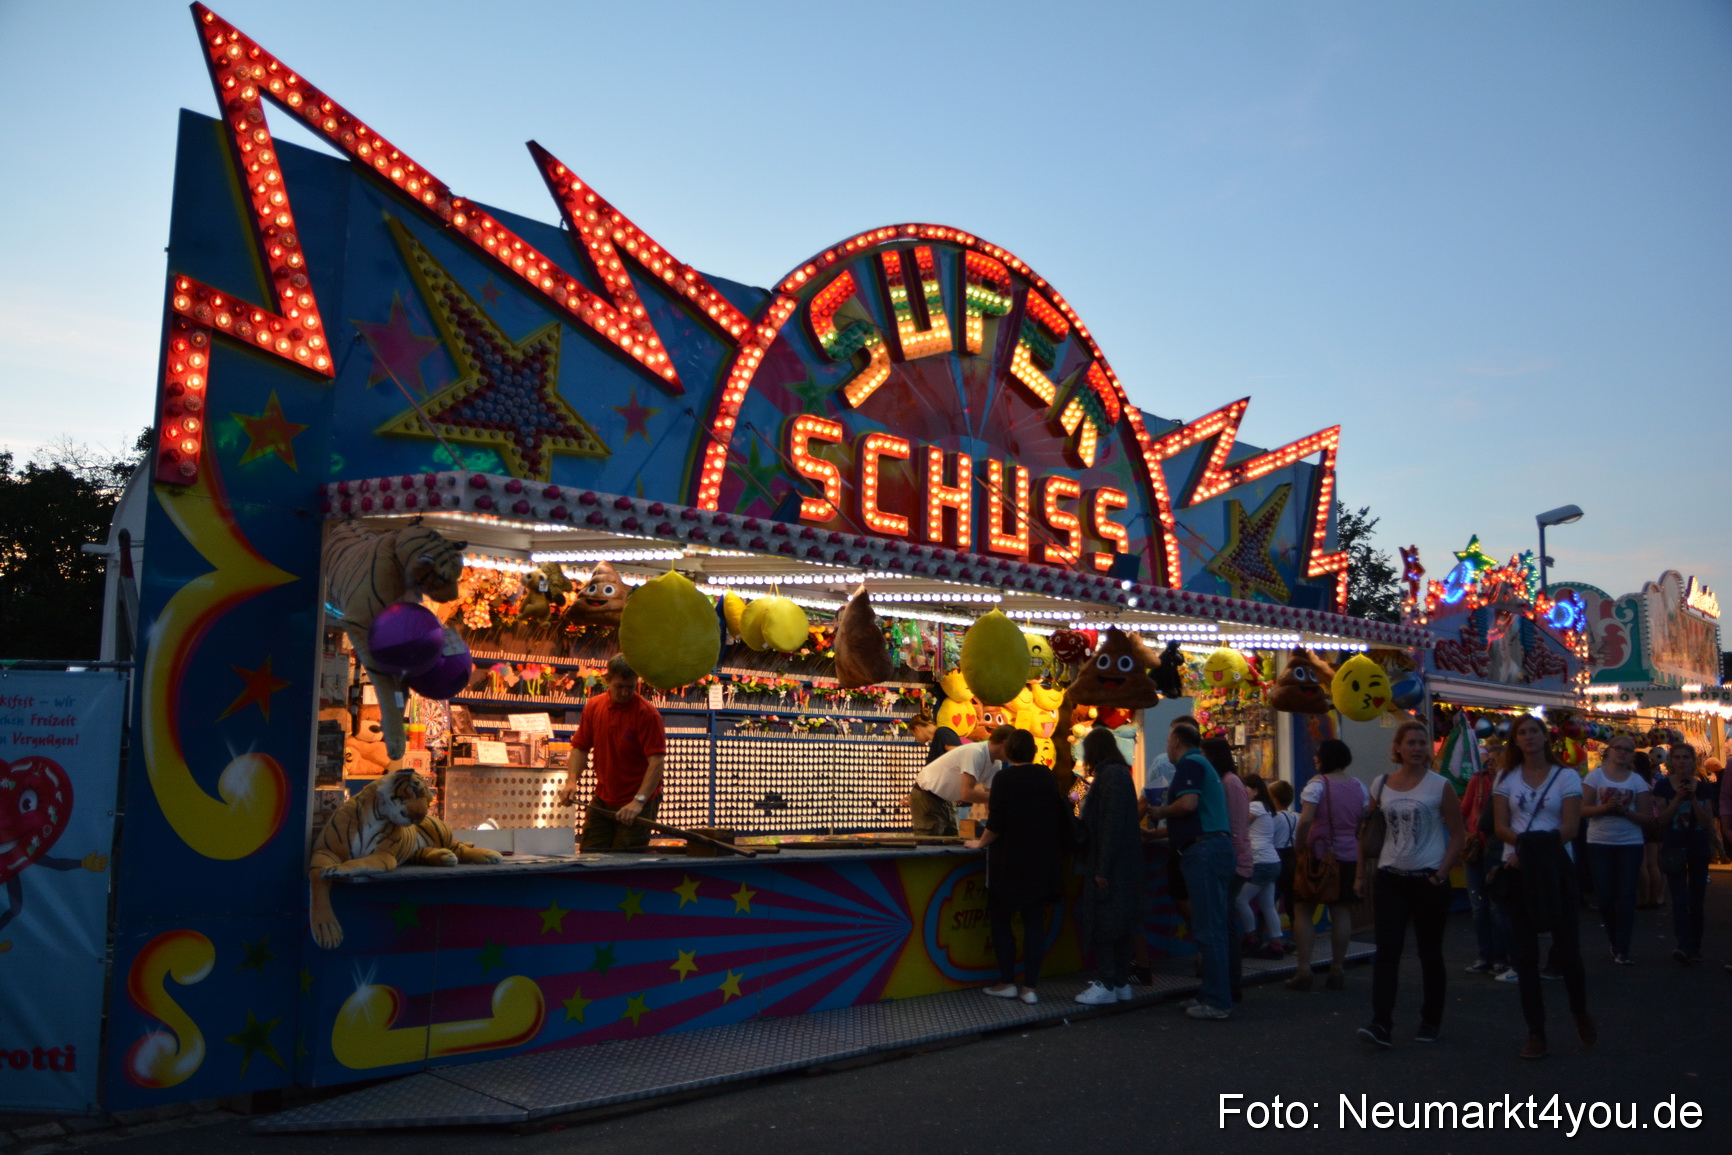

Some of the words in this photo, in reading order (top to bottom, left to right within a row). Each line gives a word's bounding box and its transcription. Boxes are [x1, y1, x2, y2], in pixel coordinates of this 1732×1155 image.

[809, 245, 1121, 469] SUPER
[789, 413, 1129, 572] SCHUSS
[54, 695, 76, 708] wir
[1591, 692, 1644, 703] BROT
[1689, 691, 1731, 701] POPC
[30, 713, 77, 727] Freizeit
[12, 731, 80, 749] Vergnügen!
